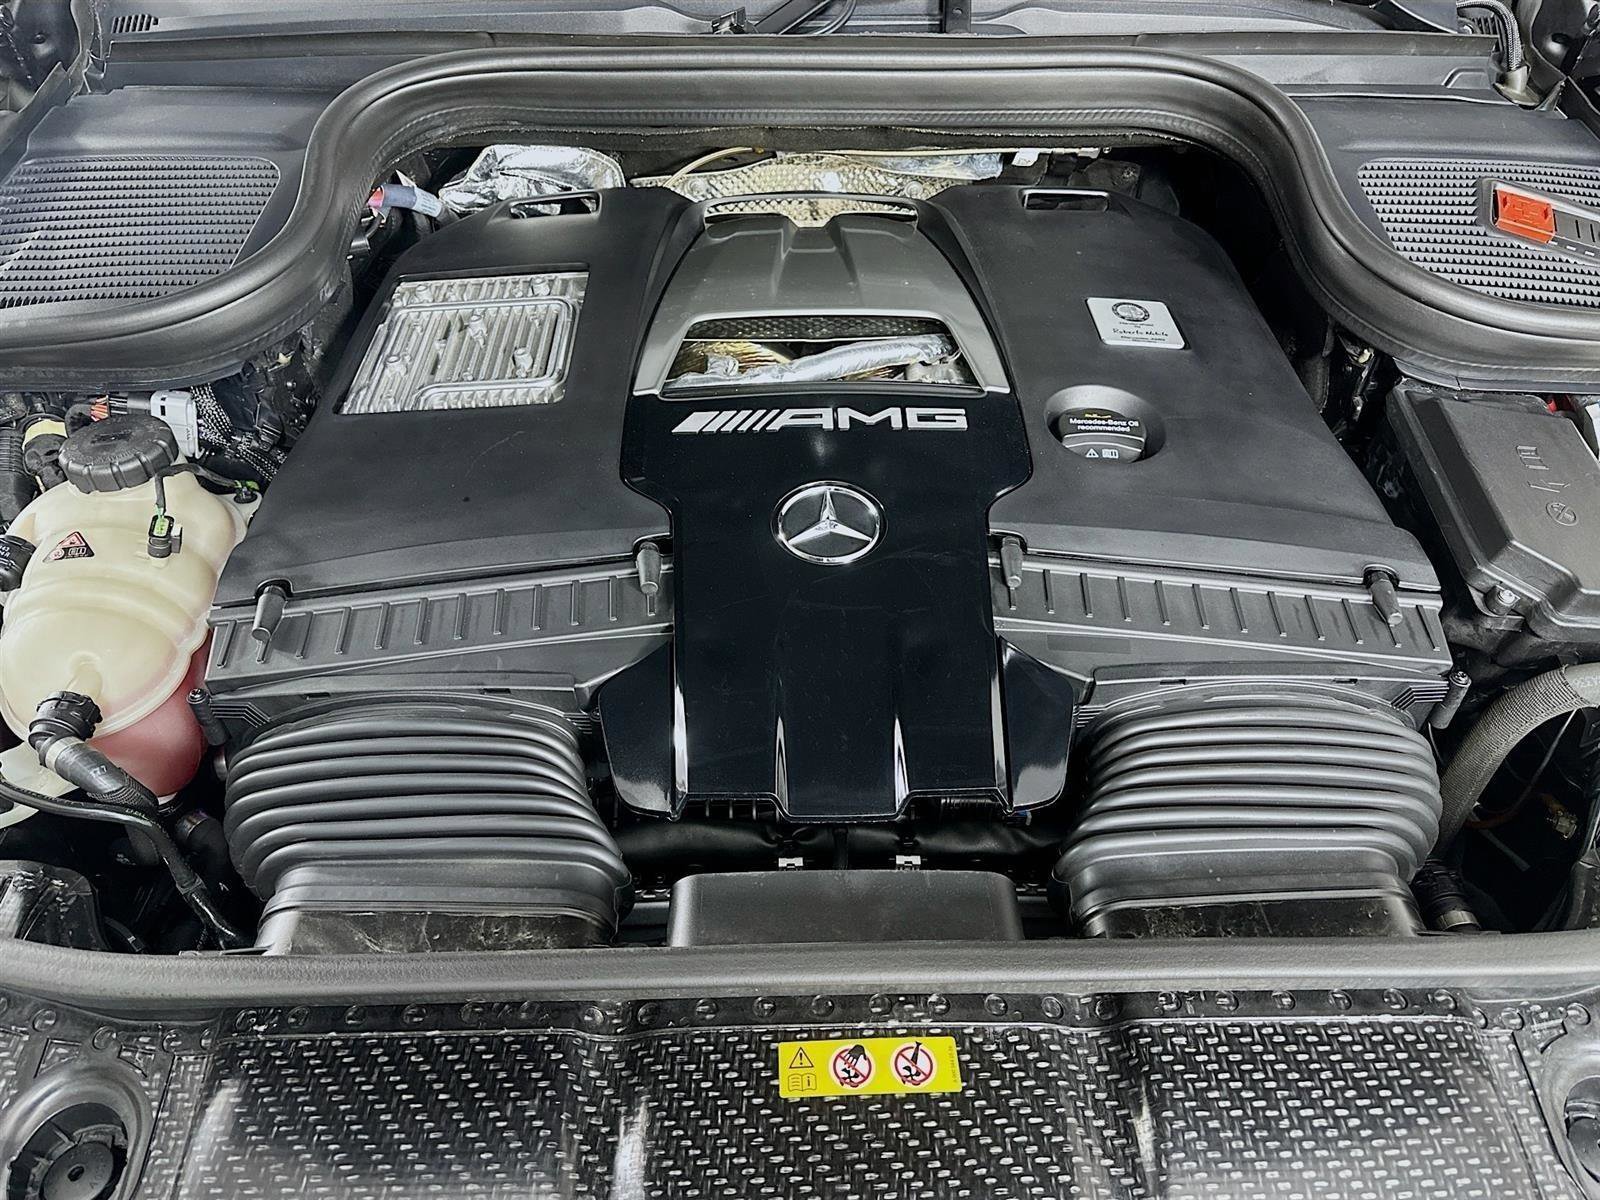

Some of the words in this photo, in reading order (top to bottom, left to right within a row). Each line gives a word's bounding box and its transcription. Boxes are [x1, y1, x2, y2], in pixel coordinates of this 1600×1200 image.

[765, 407, 968, 431] AMG
[1069, 417, 1127, 427] Mercedes-Benz
[1077, 424, 1131, 433] recommended
